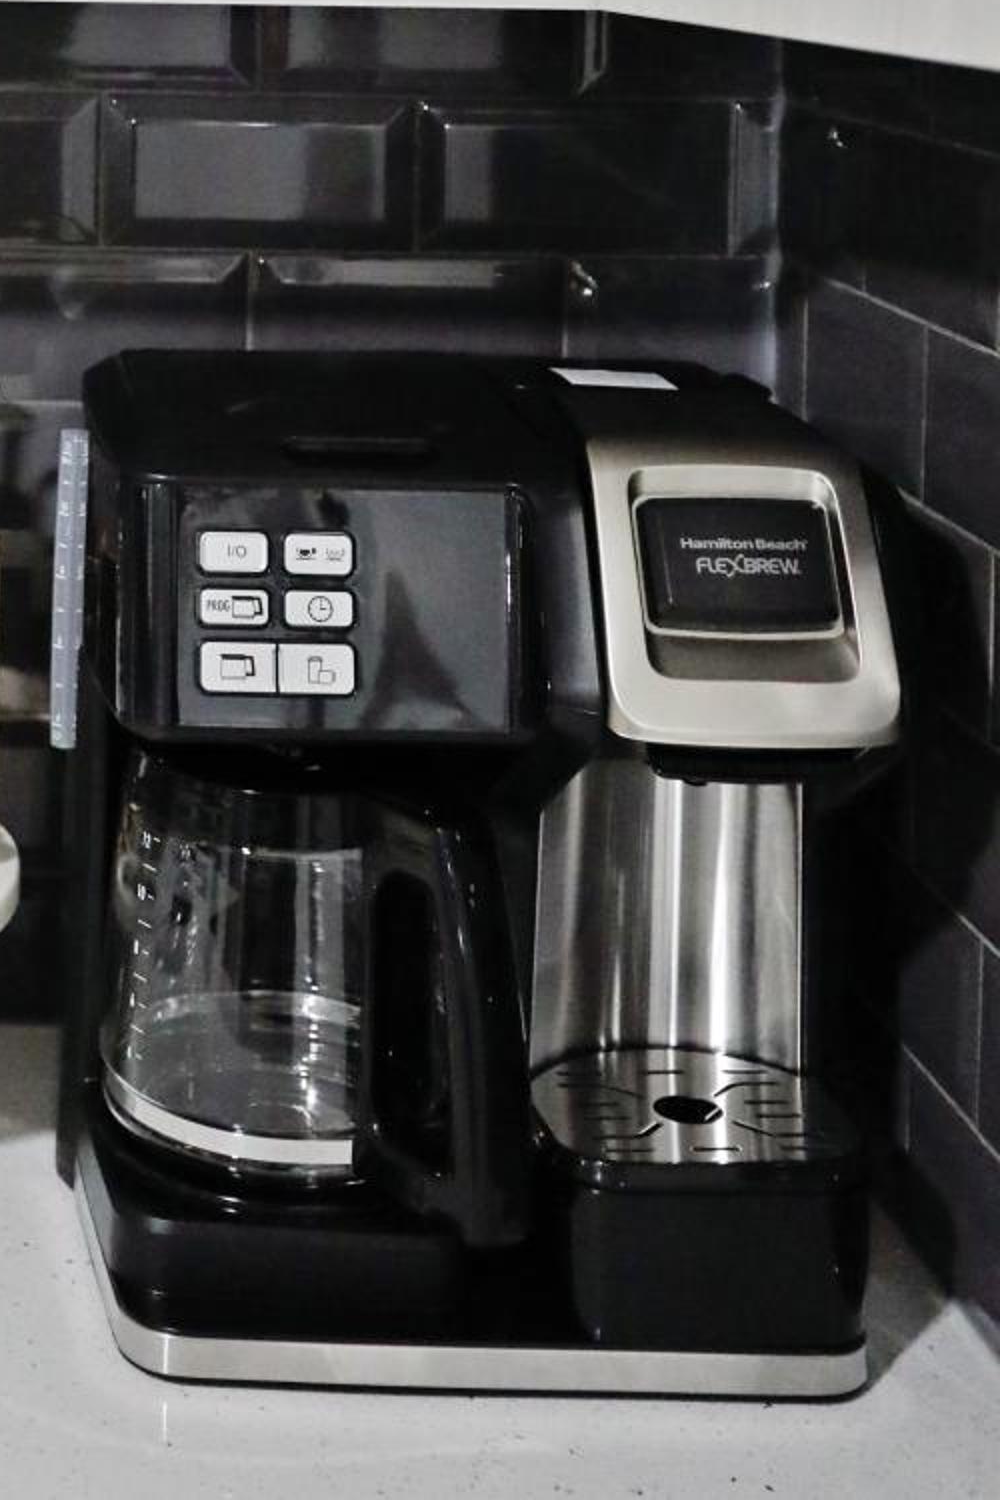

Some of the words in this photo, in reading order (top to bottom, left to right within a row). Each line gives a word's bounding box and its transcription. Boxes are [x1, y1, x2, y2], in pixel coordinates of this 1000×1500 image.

[679, 536, 754, 550] Hamilton
[755, 538, 804, 551] Beach
[695, 553, 799, 578] FLEXBREW
